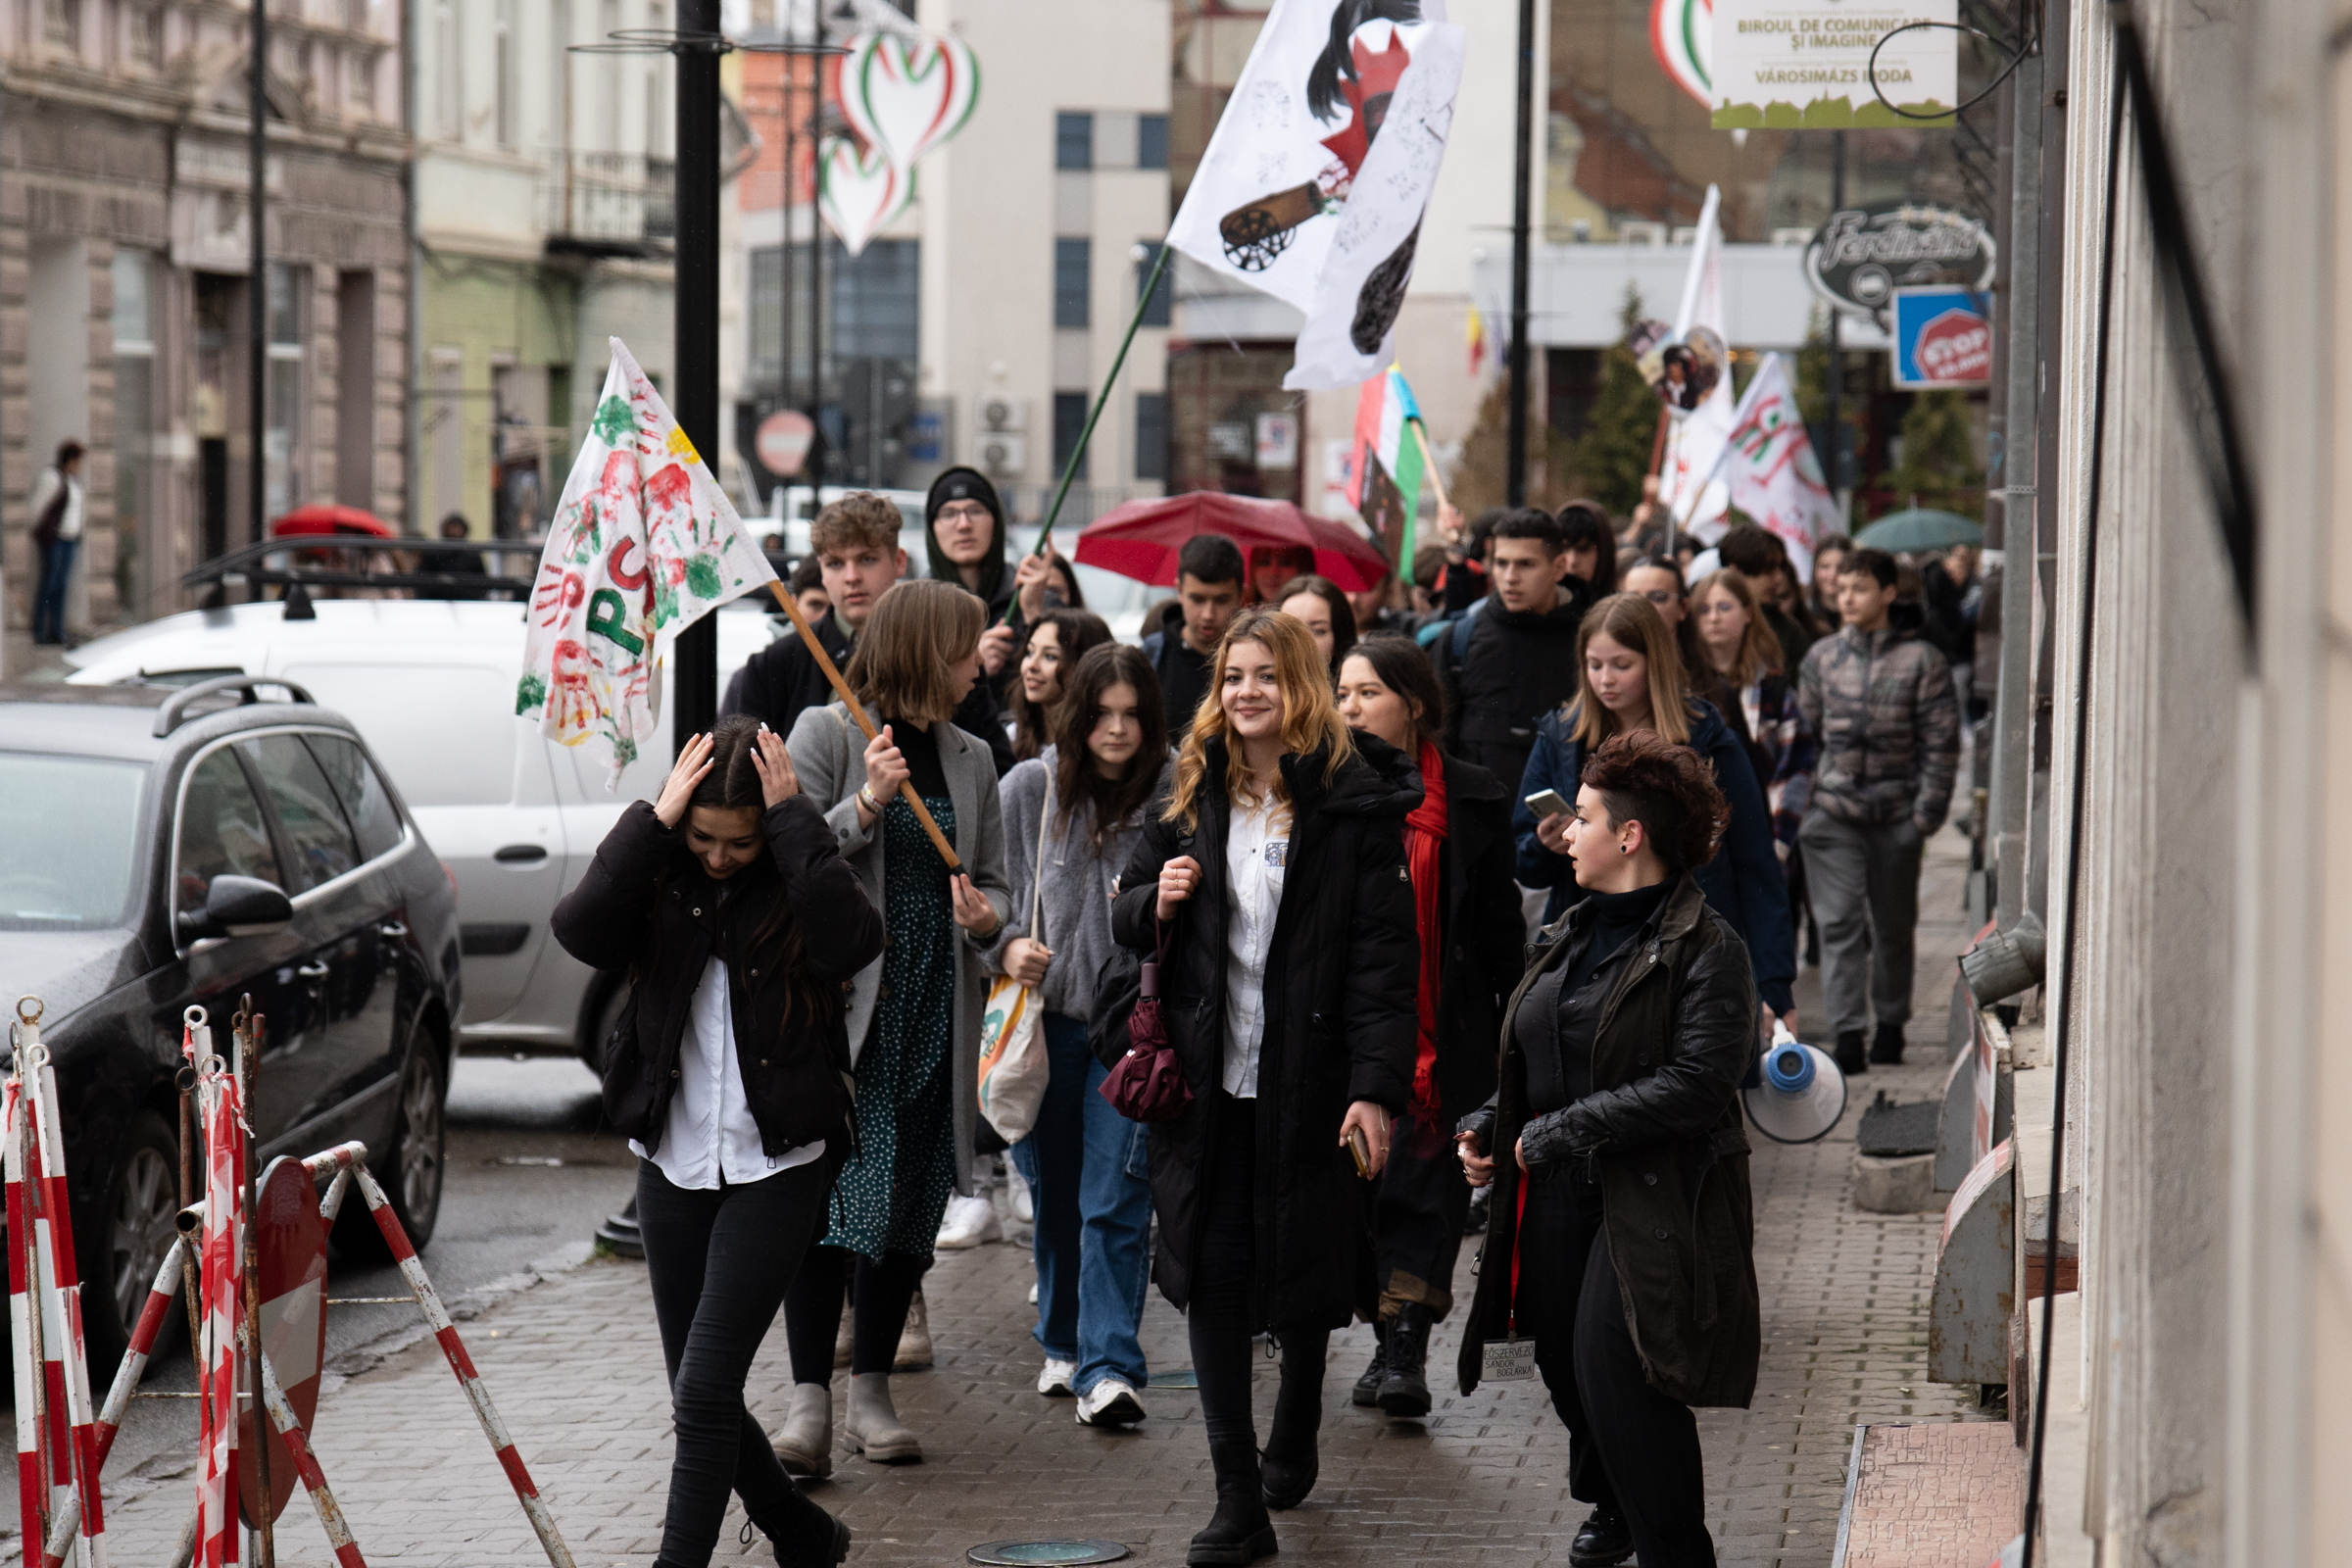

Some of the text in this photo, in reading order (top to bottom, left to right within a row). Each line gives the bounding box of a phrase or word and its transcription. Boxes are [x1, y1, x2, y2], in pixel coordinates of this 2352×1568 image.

[1738, 18, 1932, 33] BIROUL DE COMUNICARE
[1809, 33, 1877, 48] IMAGINE
[1755, 68, 1858, 83] VÁROSIMÁZS
[1923, 327, 1989, 367] STOP
